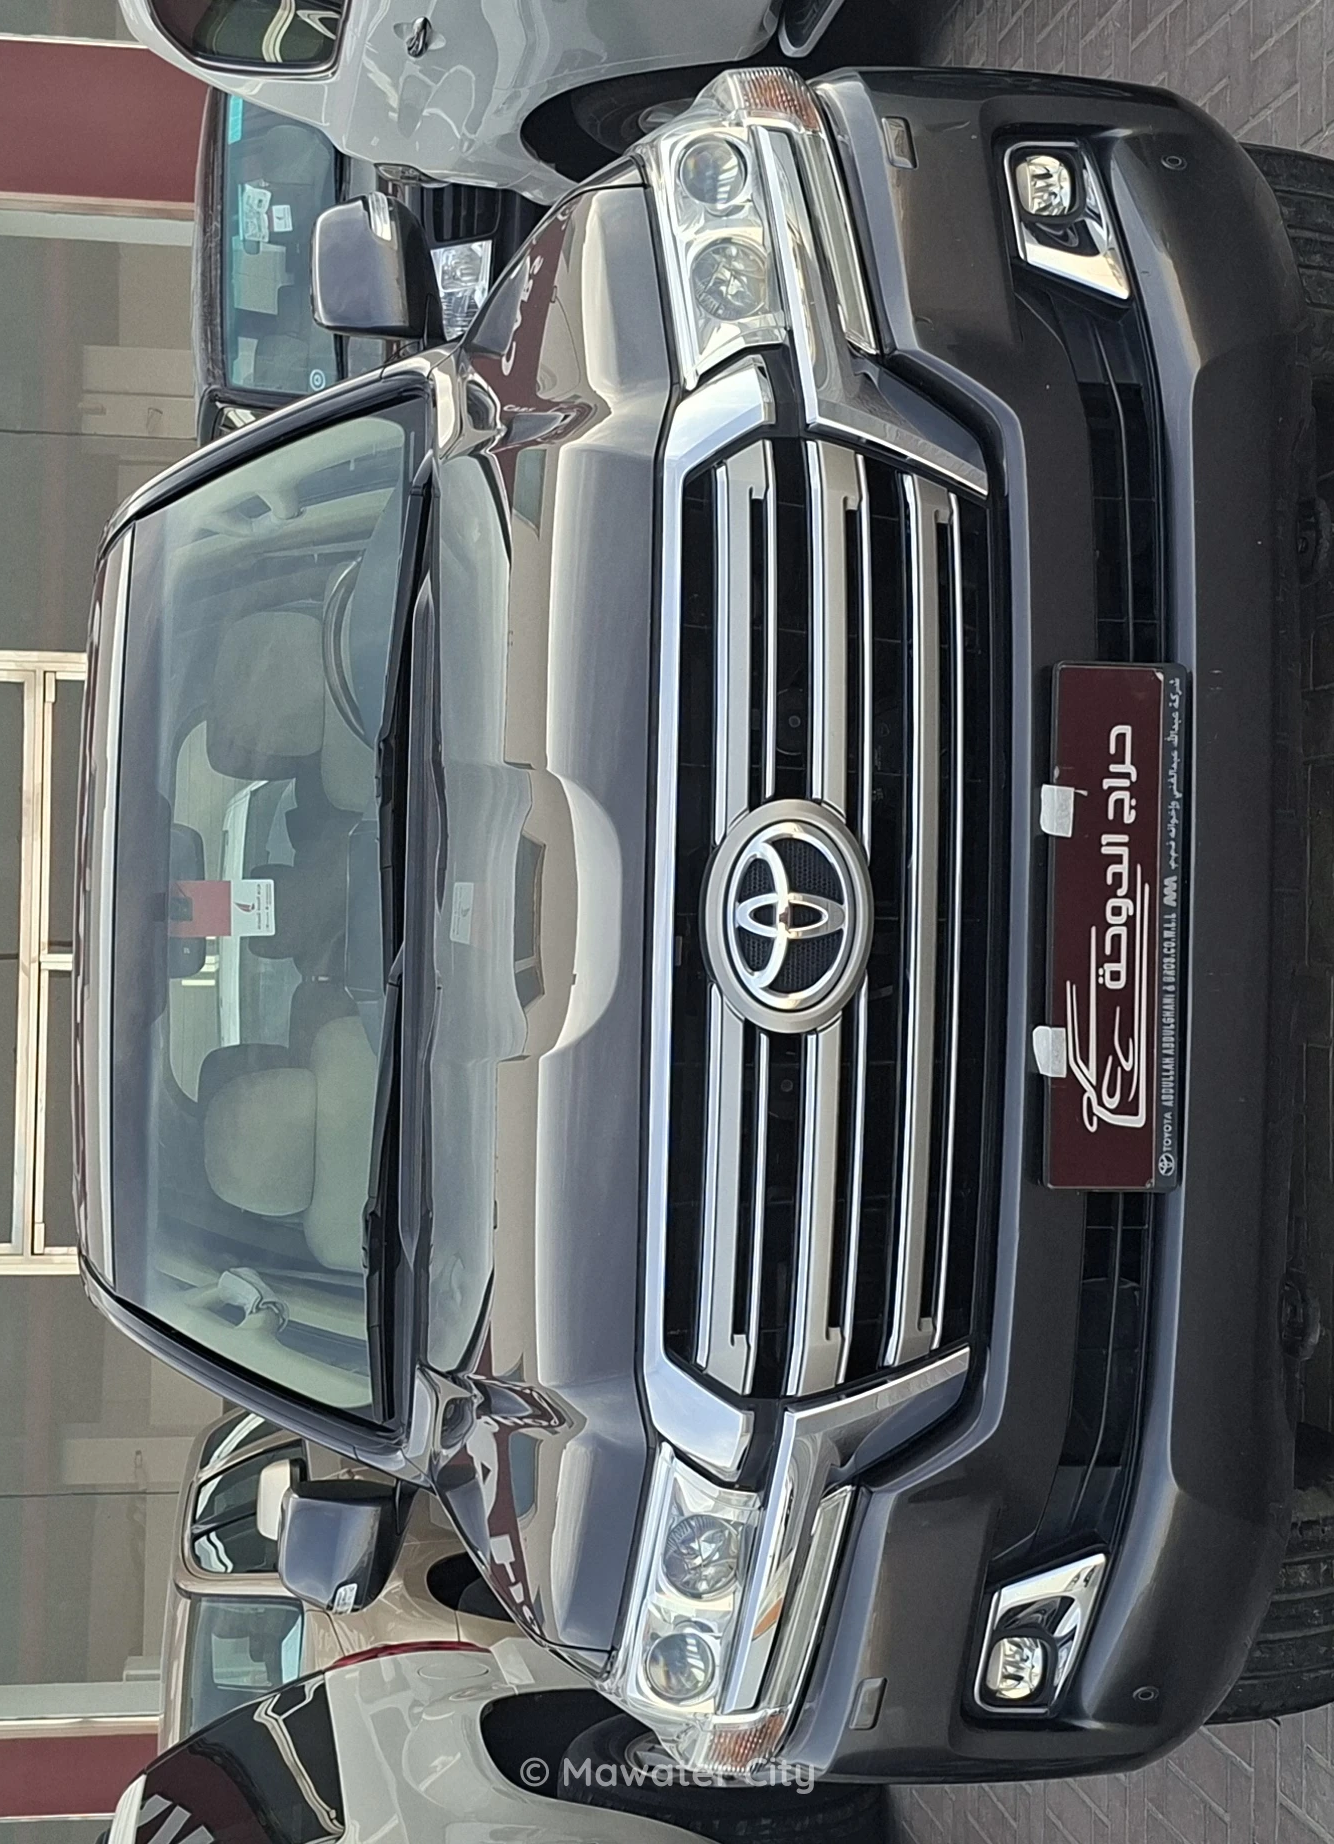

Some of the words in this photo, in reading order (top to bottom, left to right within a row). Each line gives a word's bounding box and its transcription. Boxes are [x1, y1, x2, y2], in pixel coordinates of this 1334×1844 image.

[1168, 677, 1182, 708] شركة
[1101, 724, 1137, 824] حراج
[1098, 833, 1134, 989] الدوحة
[1161, 994, 1176, 1055] ABDULGHANI
[1161, 1058, 1174, 1107] ABDULLAH
[1162, 1111, 1173, 1152] TOYOTA
